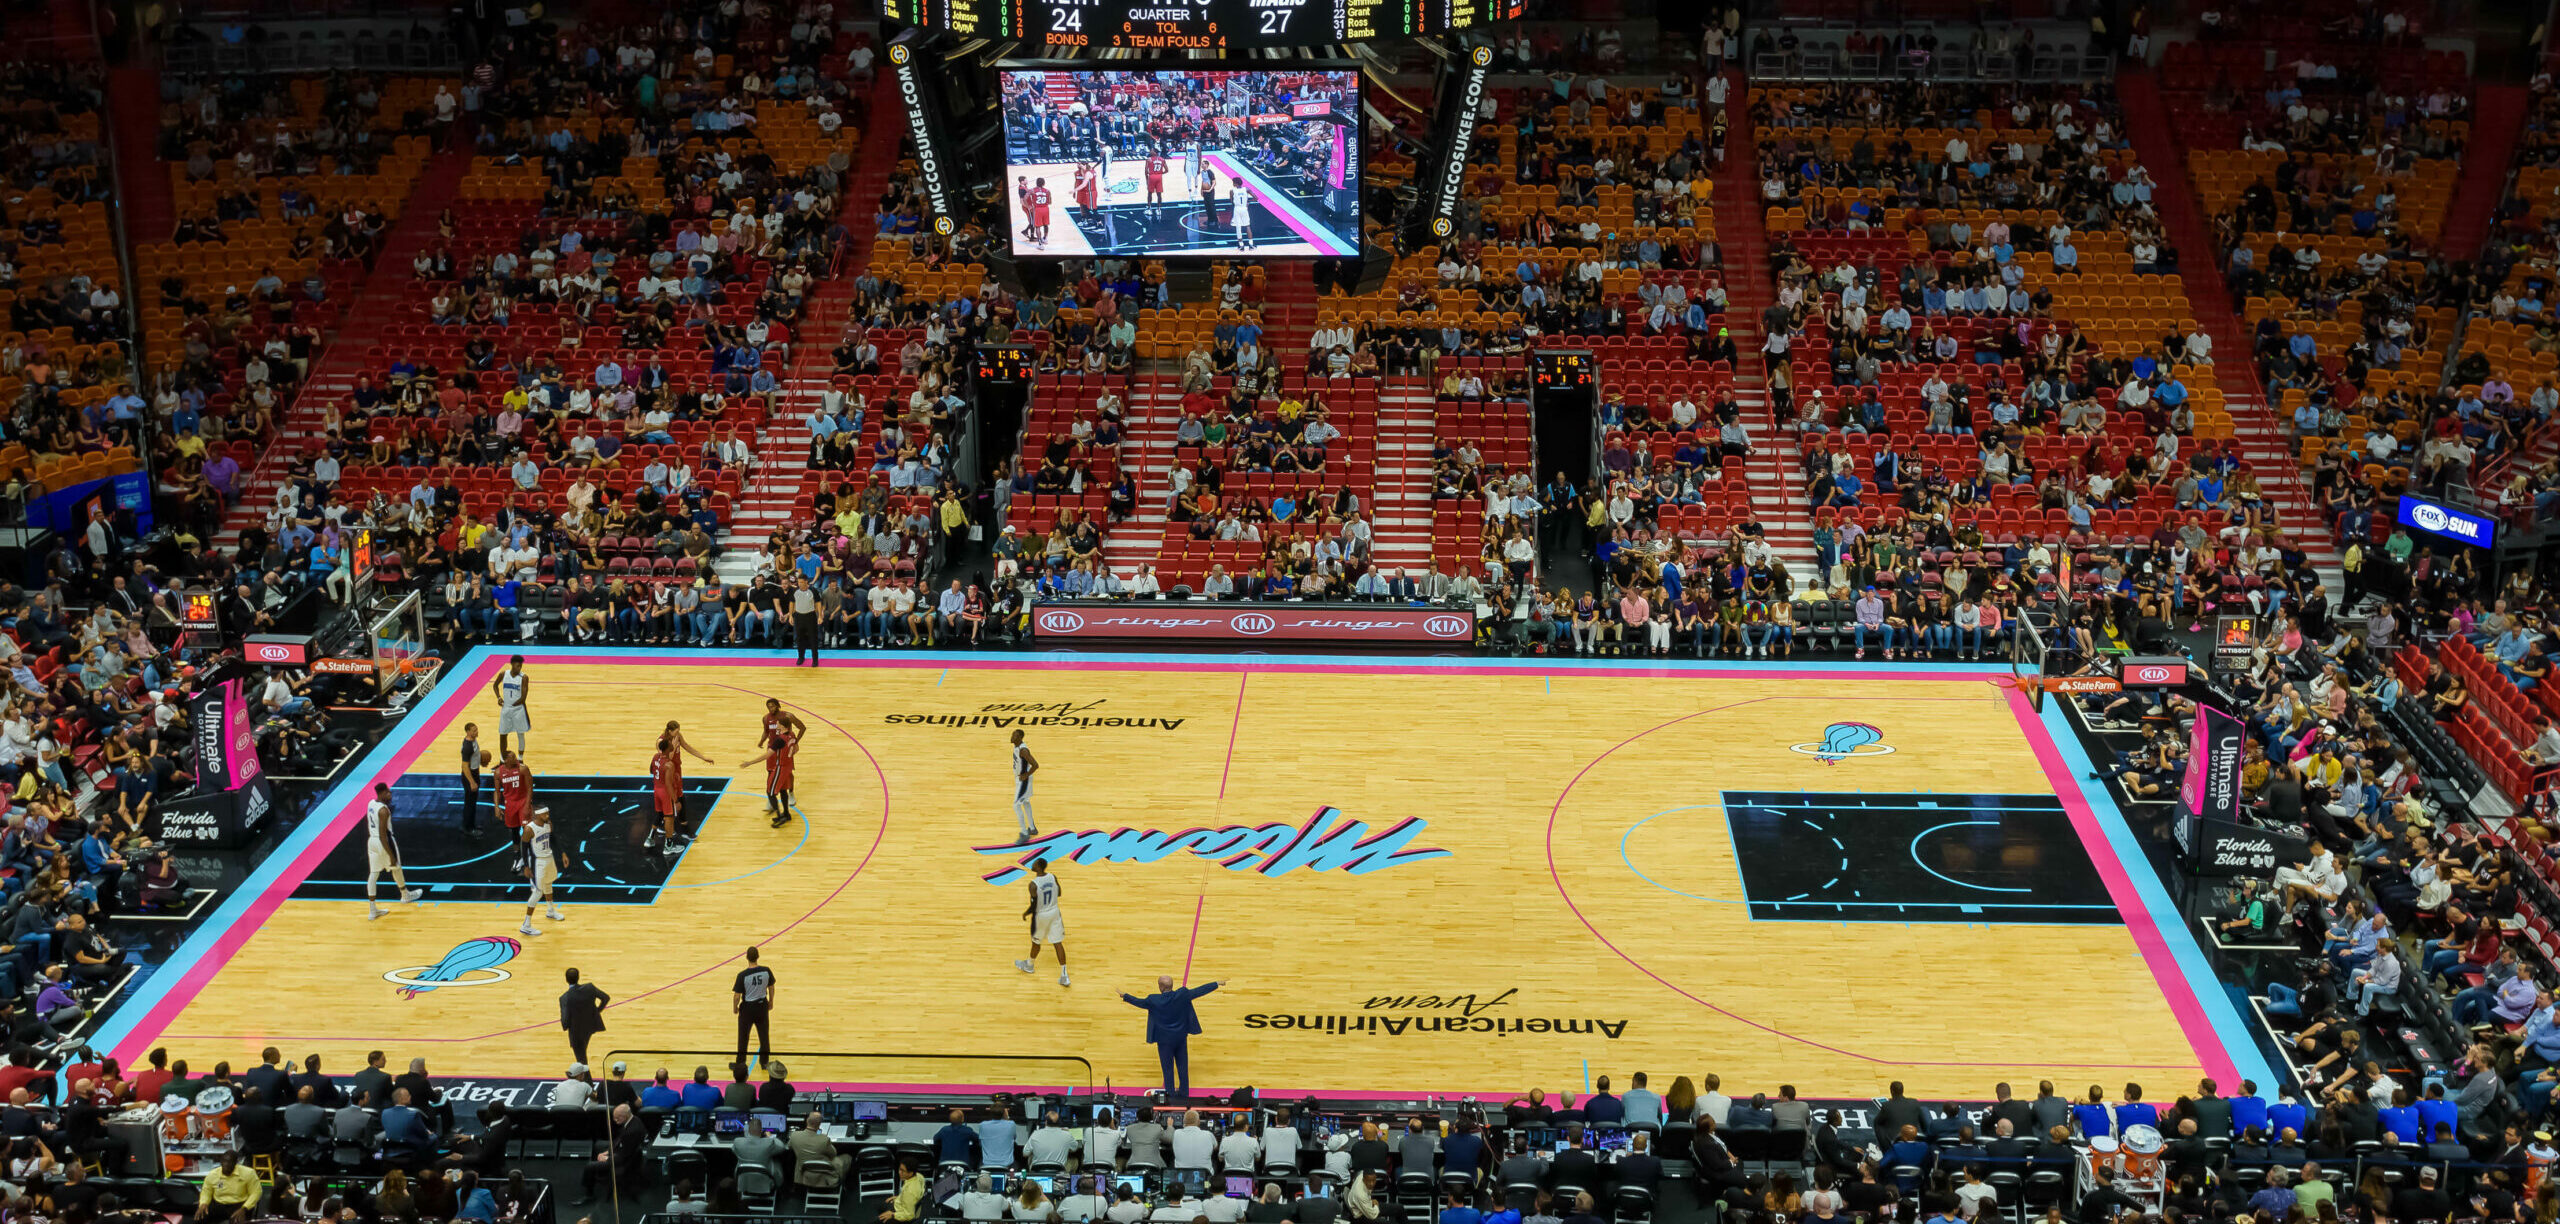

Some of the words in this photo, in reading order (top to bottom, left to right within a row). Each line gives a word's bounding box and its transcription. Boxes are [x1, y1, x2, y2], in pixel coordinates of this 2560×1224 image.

[944, 9, 950, 19] 8
[952, 10, 979, 22] Johnson
[1128, 9, 1191, 21] QUARTER
[1200, 10, 1208, 21] 1
[1333, 9, 1346, 19] 22
[1347, 8, 1371, 17] Grant
[1452, 7, 1475, 17] Johnson
[944, 19, 950, 29] 9
[952, 20, 975, 34] Olynyk
[1051, 8, 1083, 32] 24
[1259, 9, 1293, 34] 27
[1333, 19, 1346, 30] 31
[1347, 18, 1369, 28] Ross
[1452, 16, 1472, 28] Olynyk
[1123, 22, 1132, 33] 6
[1156, 22, 1182, 34] TOL
[1208, 22, 1217, 34] 6
[1336, 30, 1343, 40] 5
[1347, 28, 1376, 39] Bamba
[1045, 33, 1089, 46] BONUS
[1112, 35, 1121, 46] 3
[1128, 35, 1165, 47] TEAM
[1167, 36, 1211, 48] FOULS
[1218, 36, 1227, 47] 4
[897, 66, 947, 213] MICCOSUKEE.COM
[1440, 69, 1485, 215] MICCOSUKEE.COM
[1345, 136, 1357, 181] Ultimate
[1035, 196, 1047, 204] 20
[998, 350, 1020, 360] 1:16
[1557, 356, 1579, 366] 1:16
[979, 367, 994, 378] 24
[1019, 367, 1033, 378] 27
[1537, 373, 1552, 384] 24
[1577, 373, 1592, 384] 27
[2420, 508, 2440, 522] FOX
[1046, 614, 1077, 629] KIA
[1091, 615, 1223, 628] stinger
[1237, 617, 1268, 631] KIA
[1283, 617, 1415, 631] stinger
[1429, 619, 1462, 634] KIA
[265, 648, 285, 658] KIA
[2142, 669, 2166, 679] KIA
[979, 699, 1108, 717] Arena
[885, 713, 1186, 730] AmericanAirlines
[197, 713, 206, 760] SOFTWARE
[205, 701, 223, 774] Ultimate
[237, 734, 249, 749] KIA
[242, 761, 256, 777] KIA
[2209, 750, 2219, 798] SOFTWARE
[2216, 736, 2239, 810] Ultimate
[161, 810, 217, 825] Florida
[245, 800, 269, 829] adidas
[161, 825, 193, 839] Blue
[2216, 837, 2274, 852] Florida
[2214, 853, 2248, 866] Blue
[751, 974, 763, 987] 45
[1356, 987, 1519, 1017] Arena
[1243, 1013, 1629, 1039] AmericanAirlines
